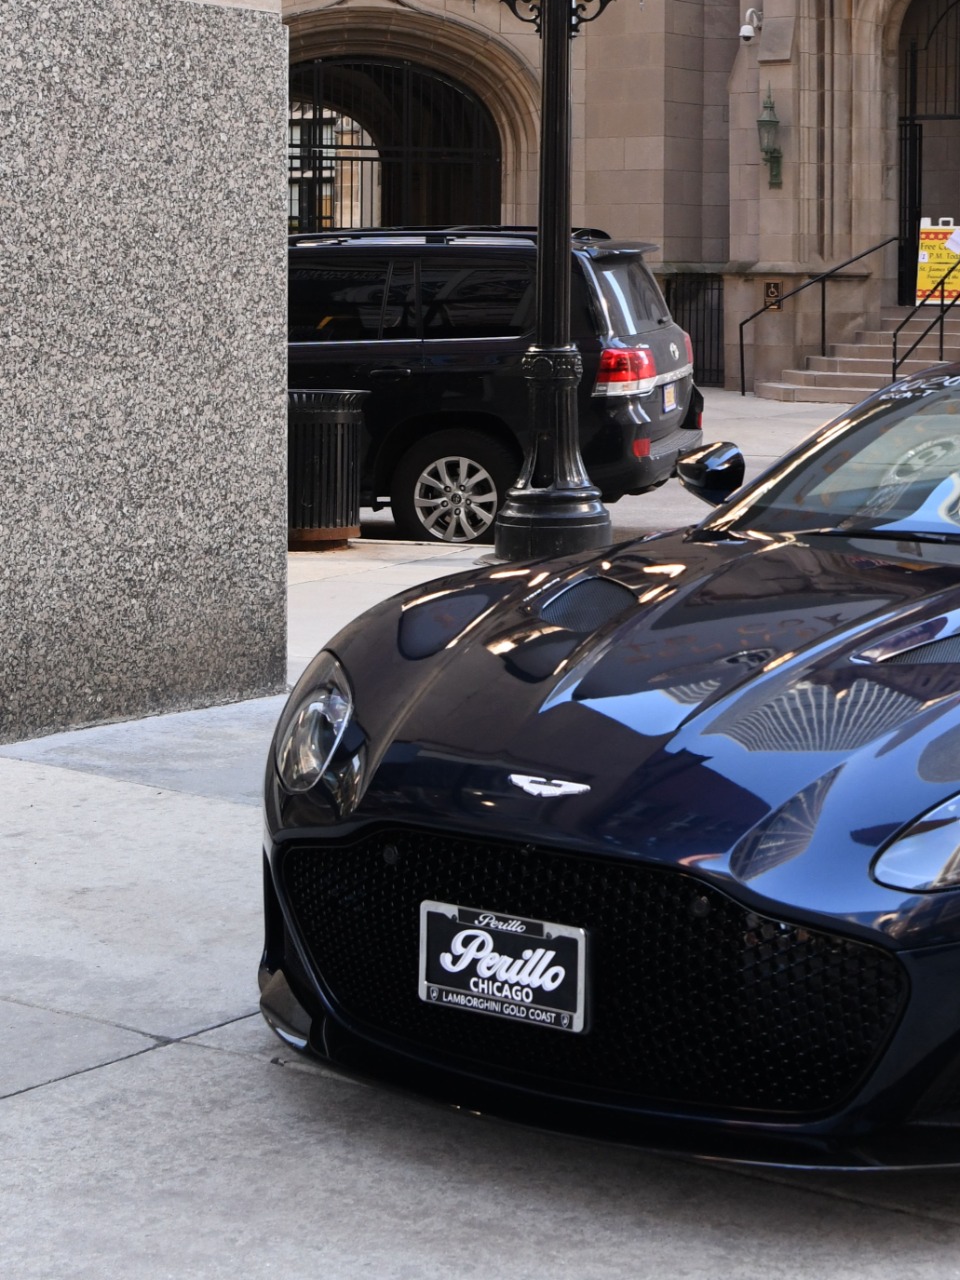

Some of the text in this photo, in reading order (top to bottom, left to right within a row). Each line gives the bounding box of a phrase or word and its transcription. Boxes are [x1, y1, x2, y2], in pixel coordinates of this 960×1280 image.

[920, 242, 936, 250] Free
[474, 913, 526, 933] Perillo
[440, 929, 565, 992] Perillo
[470, 977, 533, 1003] CHICAGO
[442, 991, 556, 1023] LAMBORGHINI GOLD COAST
